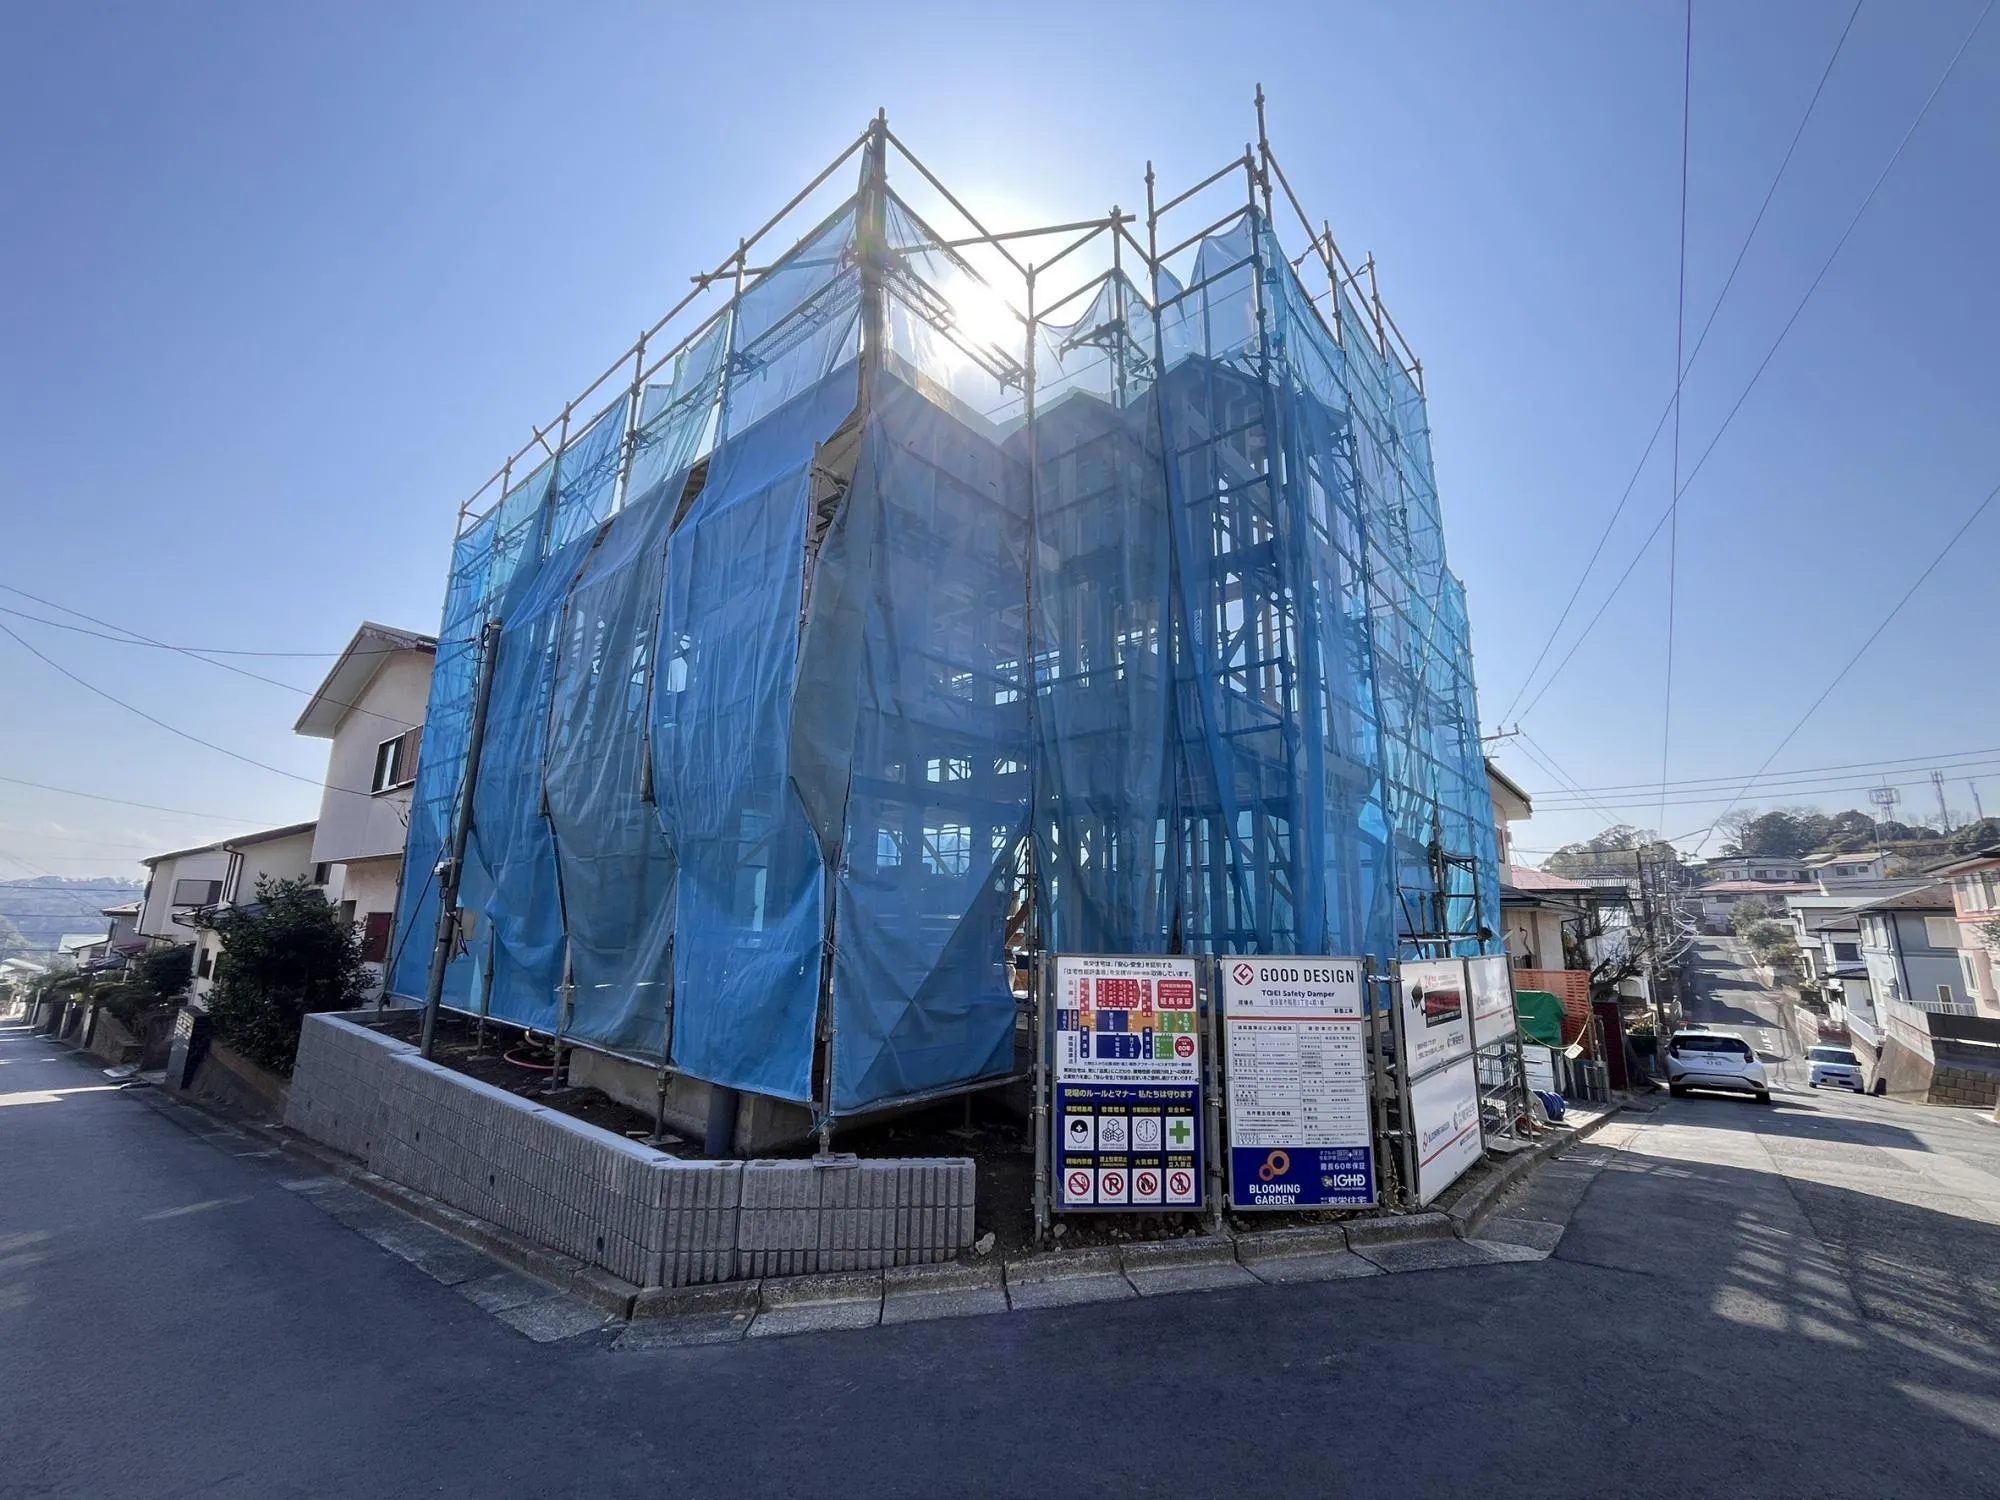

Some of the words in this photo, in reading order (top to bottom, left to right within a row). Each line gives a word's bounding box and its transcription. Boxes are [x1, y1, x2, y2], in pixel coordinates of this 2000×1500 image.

[1260, 968, 1299, 982] GOOD
[1304, 969, 1354, 983] DESIGN
[1283, 990, 1306, 998] Safety
[1307, 990, 1335, 999] Damper
[1064, 1088, 1136, 1098] 現場のルールとマナー
[1138, 1089, 1193, 1099] 私たちは守ります
[1249, 1184, 1301, 1195] BLOOMING
[1255, 1195, 1296, 1205] GARDEN
